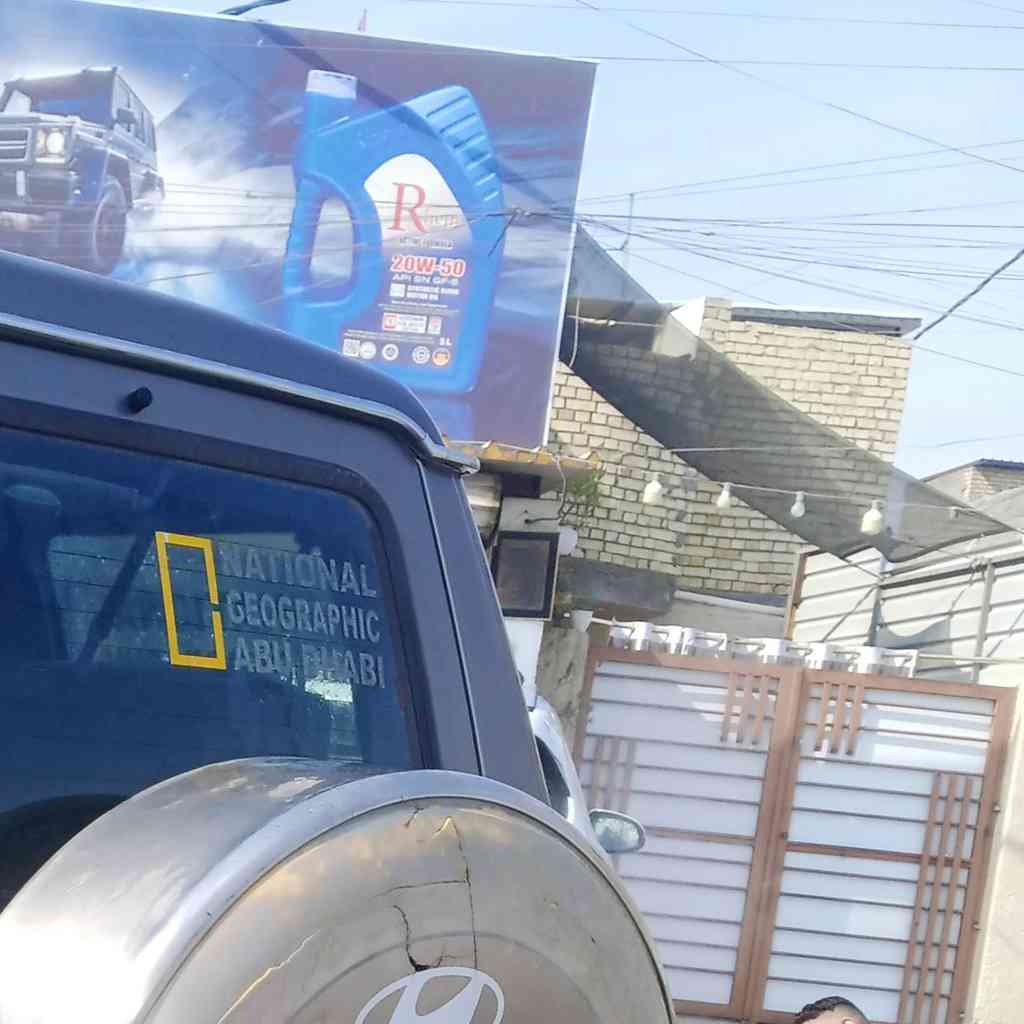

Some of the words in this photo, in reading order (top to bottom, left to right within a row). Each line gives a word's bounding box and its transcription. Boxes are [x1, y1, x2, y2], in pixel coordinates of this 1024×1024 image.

[390, 254, 467, 278] 20W-50
[219, 545, 377, 598] NATIONAL
[227, 589, 380, 643] GEOGRAPHIC
[234, 637, 293, 674] ABU
